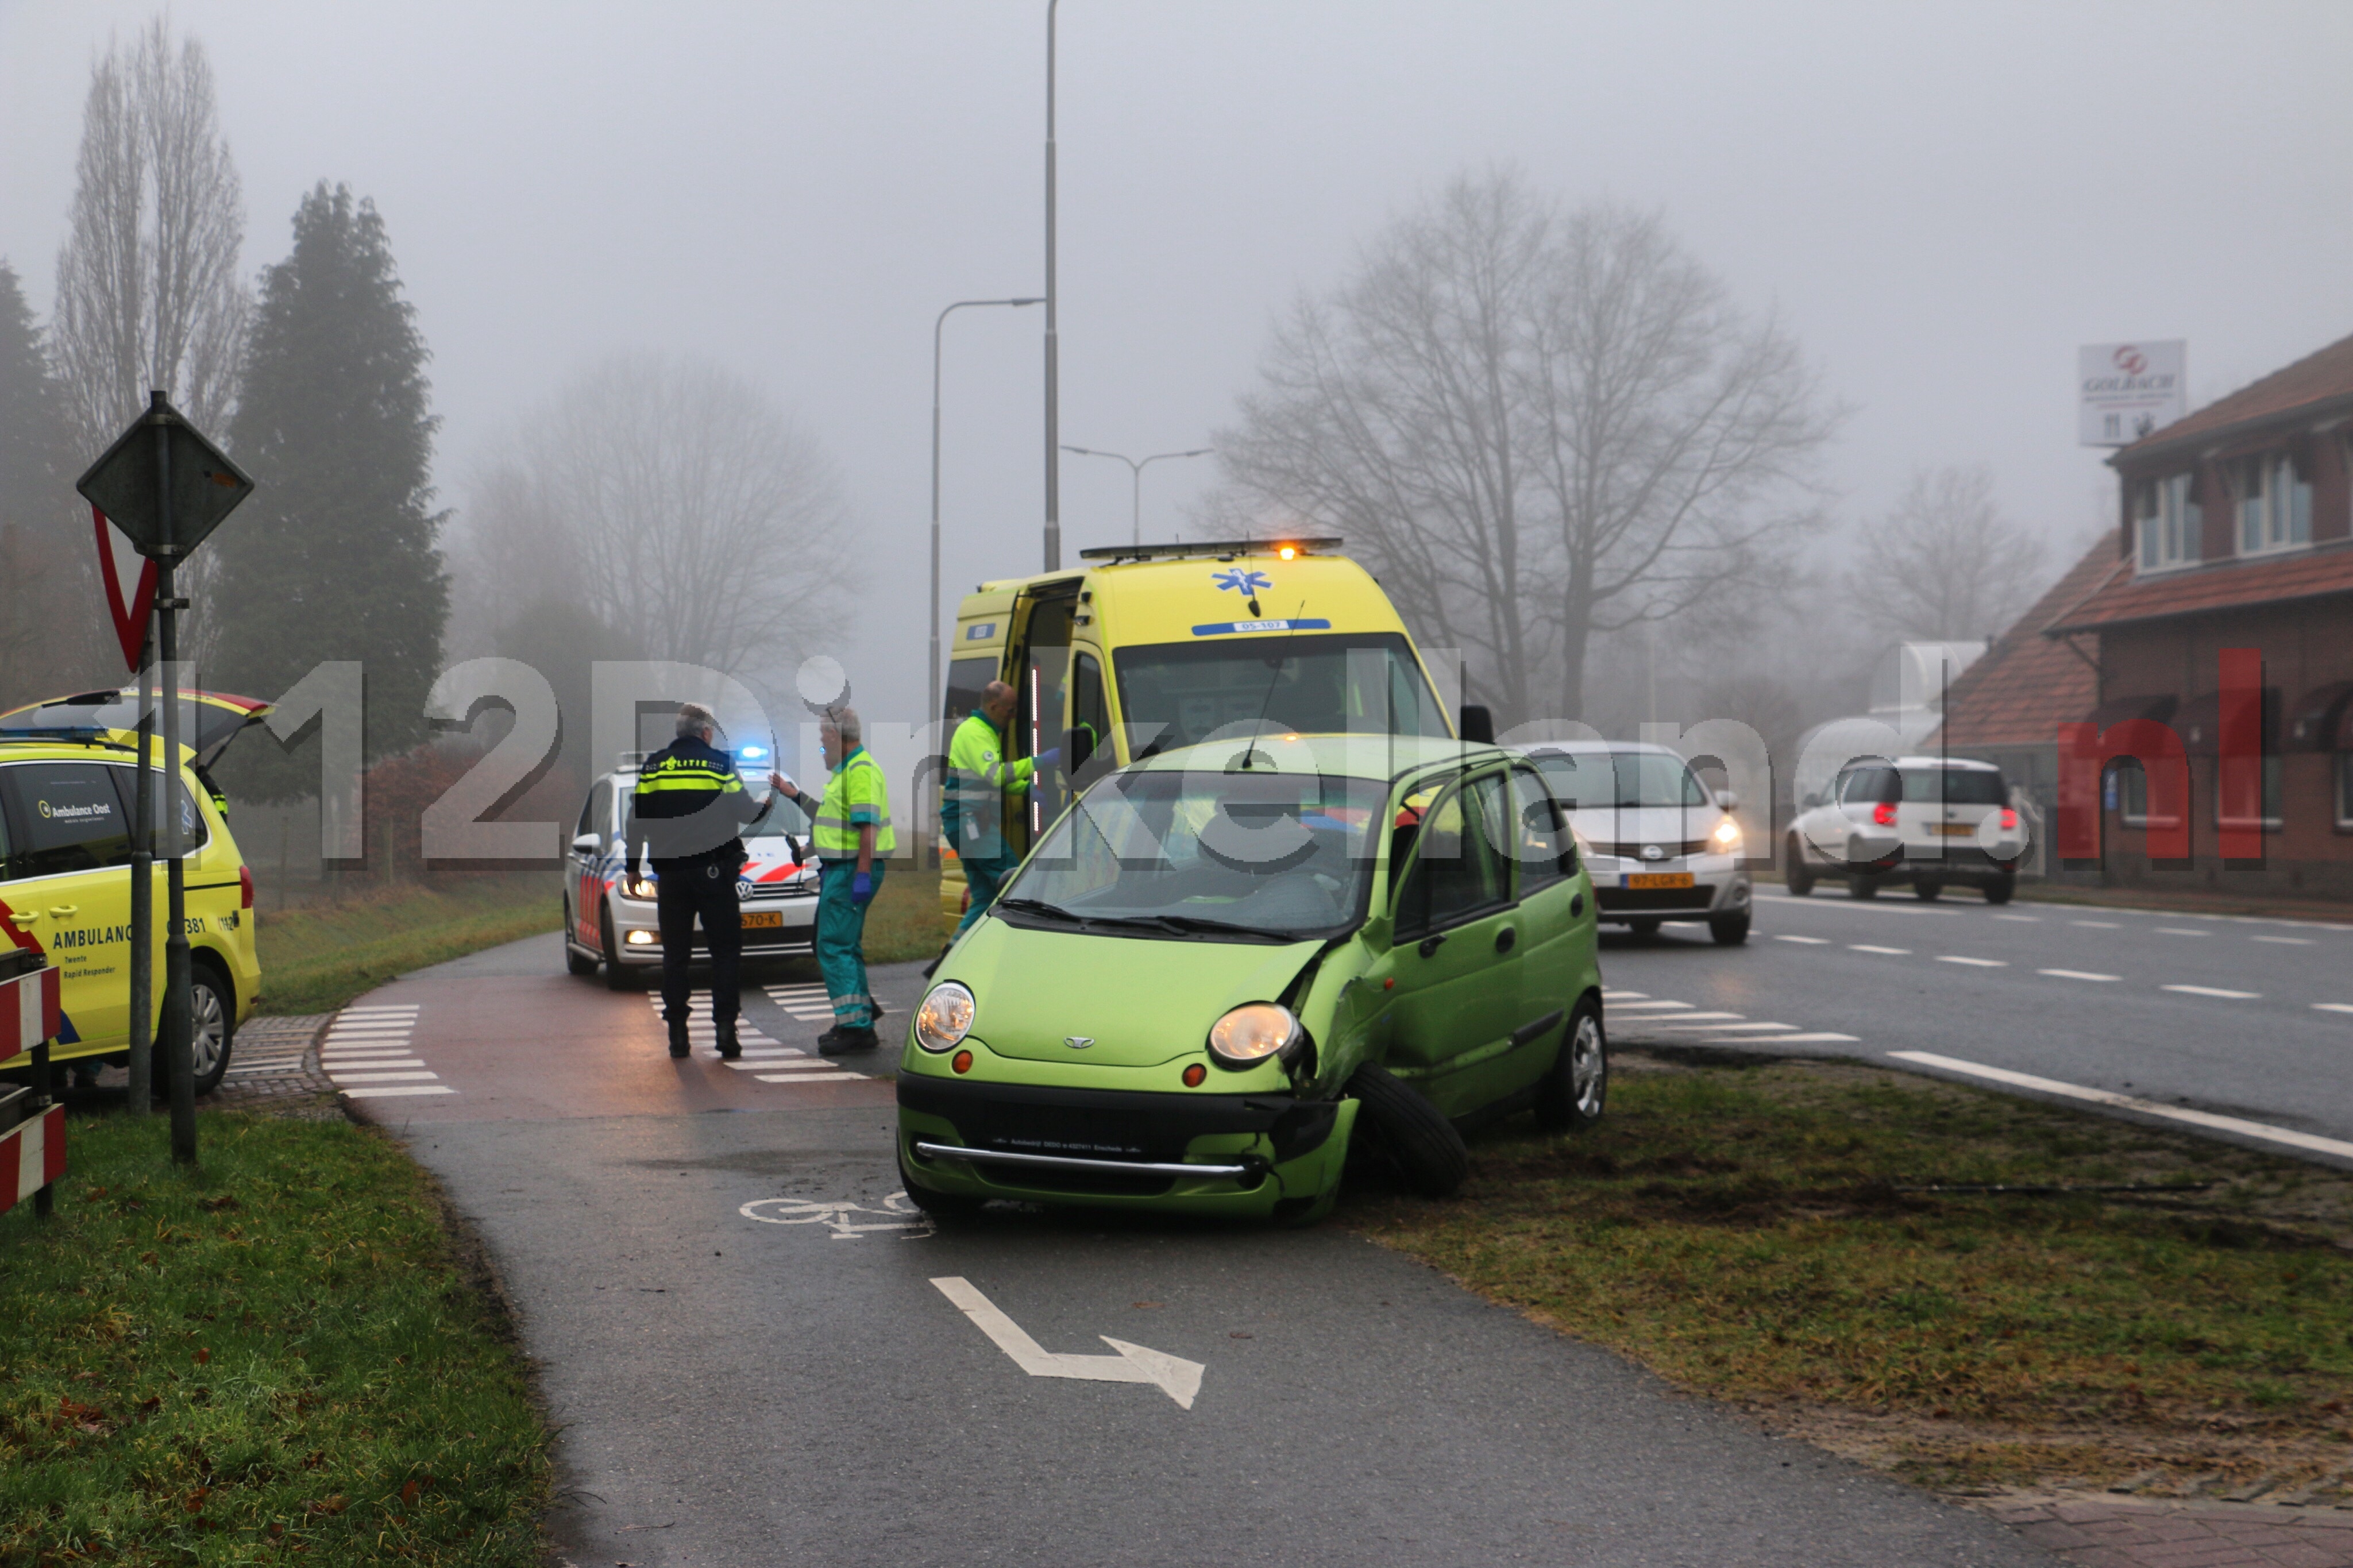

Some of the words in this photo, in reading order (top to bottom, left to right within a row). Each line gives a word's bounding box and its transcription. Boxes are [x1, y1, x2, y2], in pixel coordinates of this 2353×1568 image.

[52, 805, 92, 817] Ambulance
[92, 804, 111, 814] Oost
[53, 925, 132, 949] AMBULANC
[65, 956, 87, 964] Twente
[64, 970, 82, 979] Rapid
[84, 966, 115, 978] Responder
